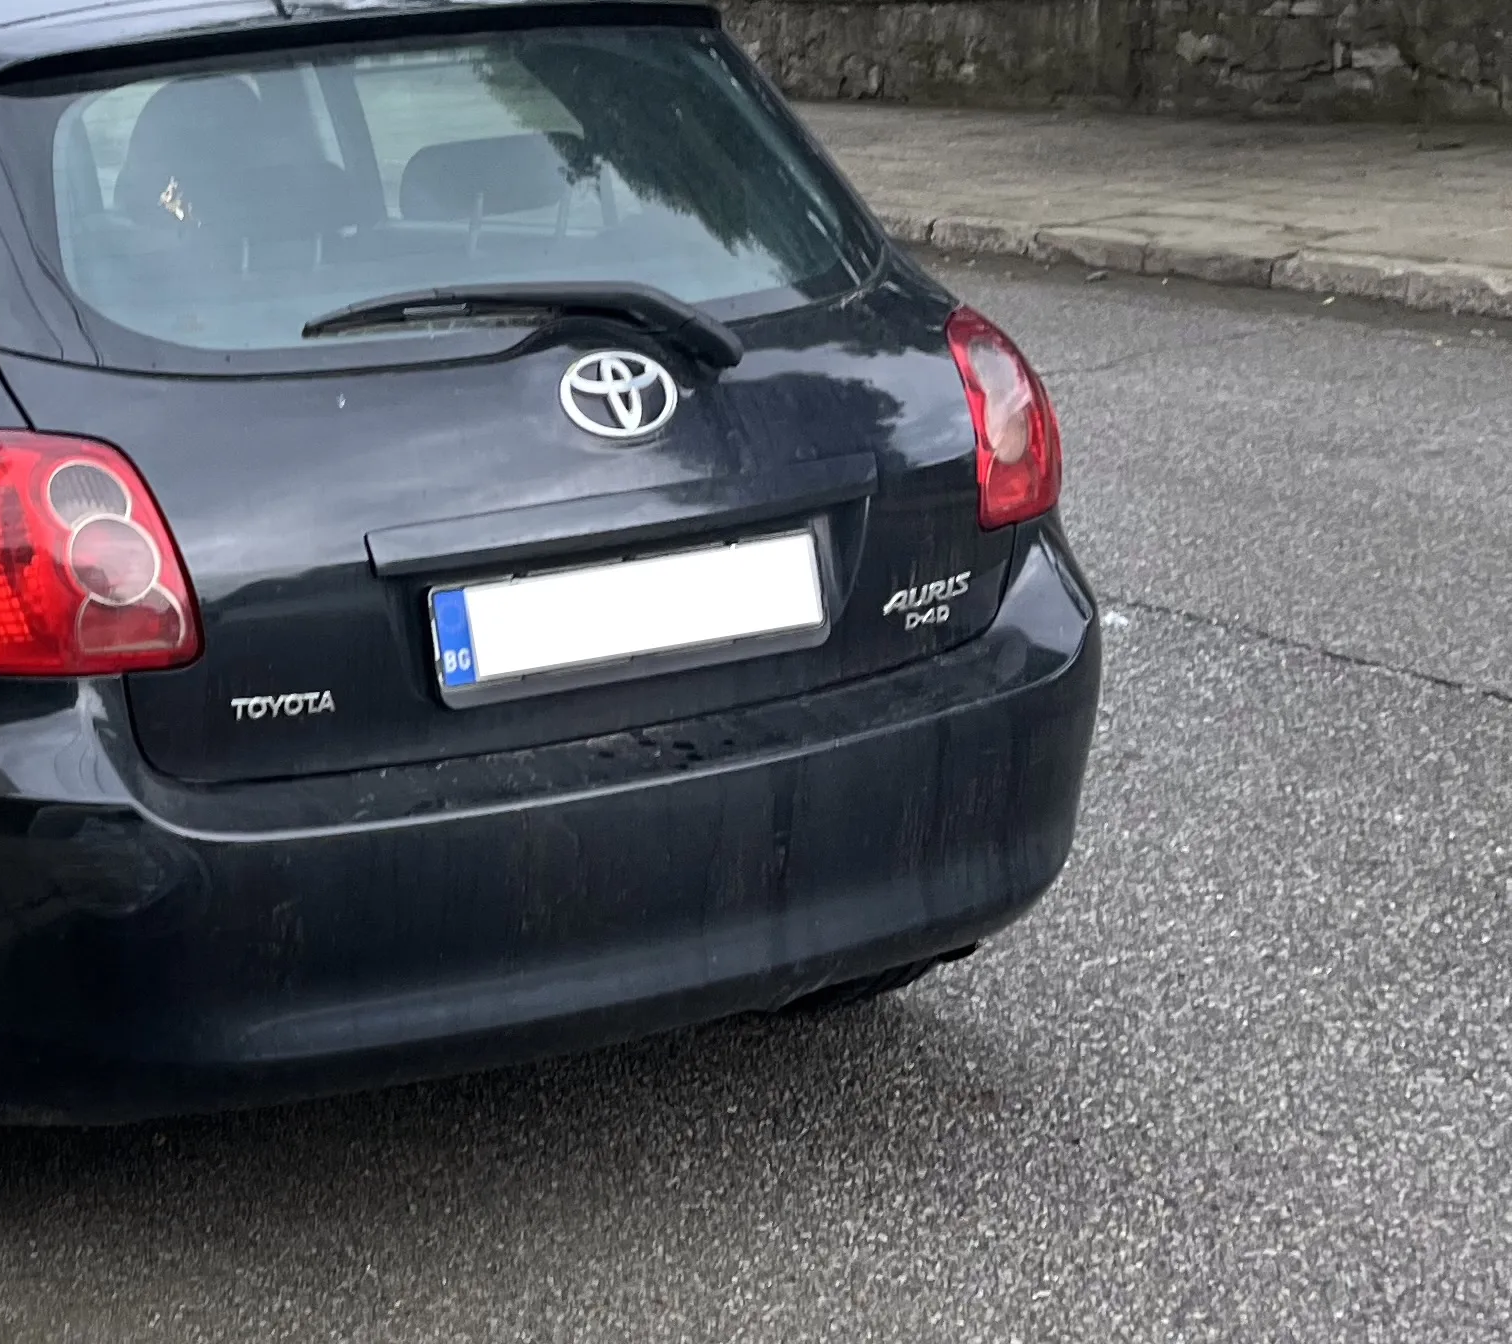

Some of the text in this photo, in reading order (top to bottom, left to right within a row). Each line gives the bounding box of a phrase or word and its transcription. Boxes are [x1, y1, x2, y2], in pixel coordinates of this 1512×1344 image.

[883, 570, 971, 616] AURIS
[444, 648, 472, 673] BG
[230, 690, 336, 722] TOYOTA
